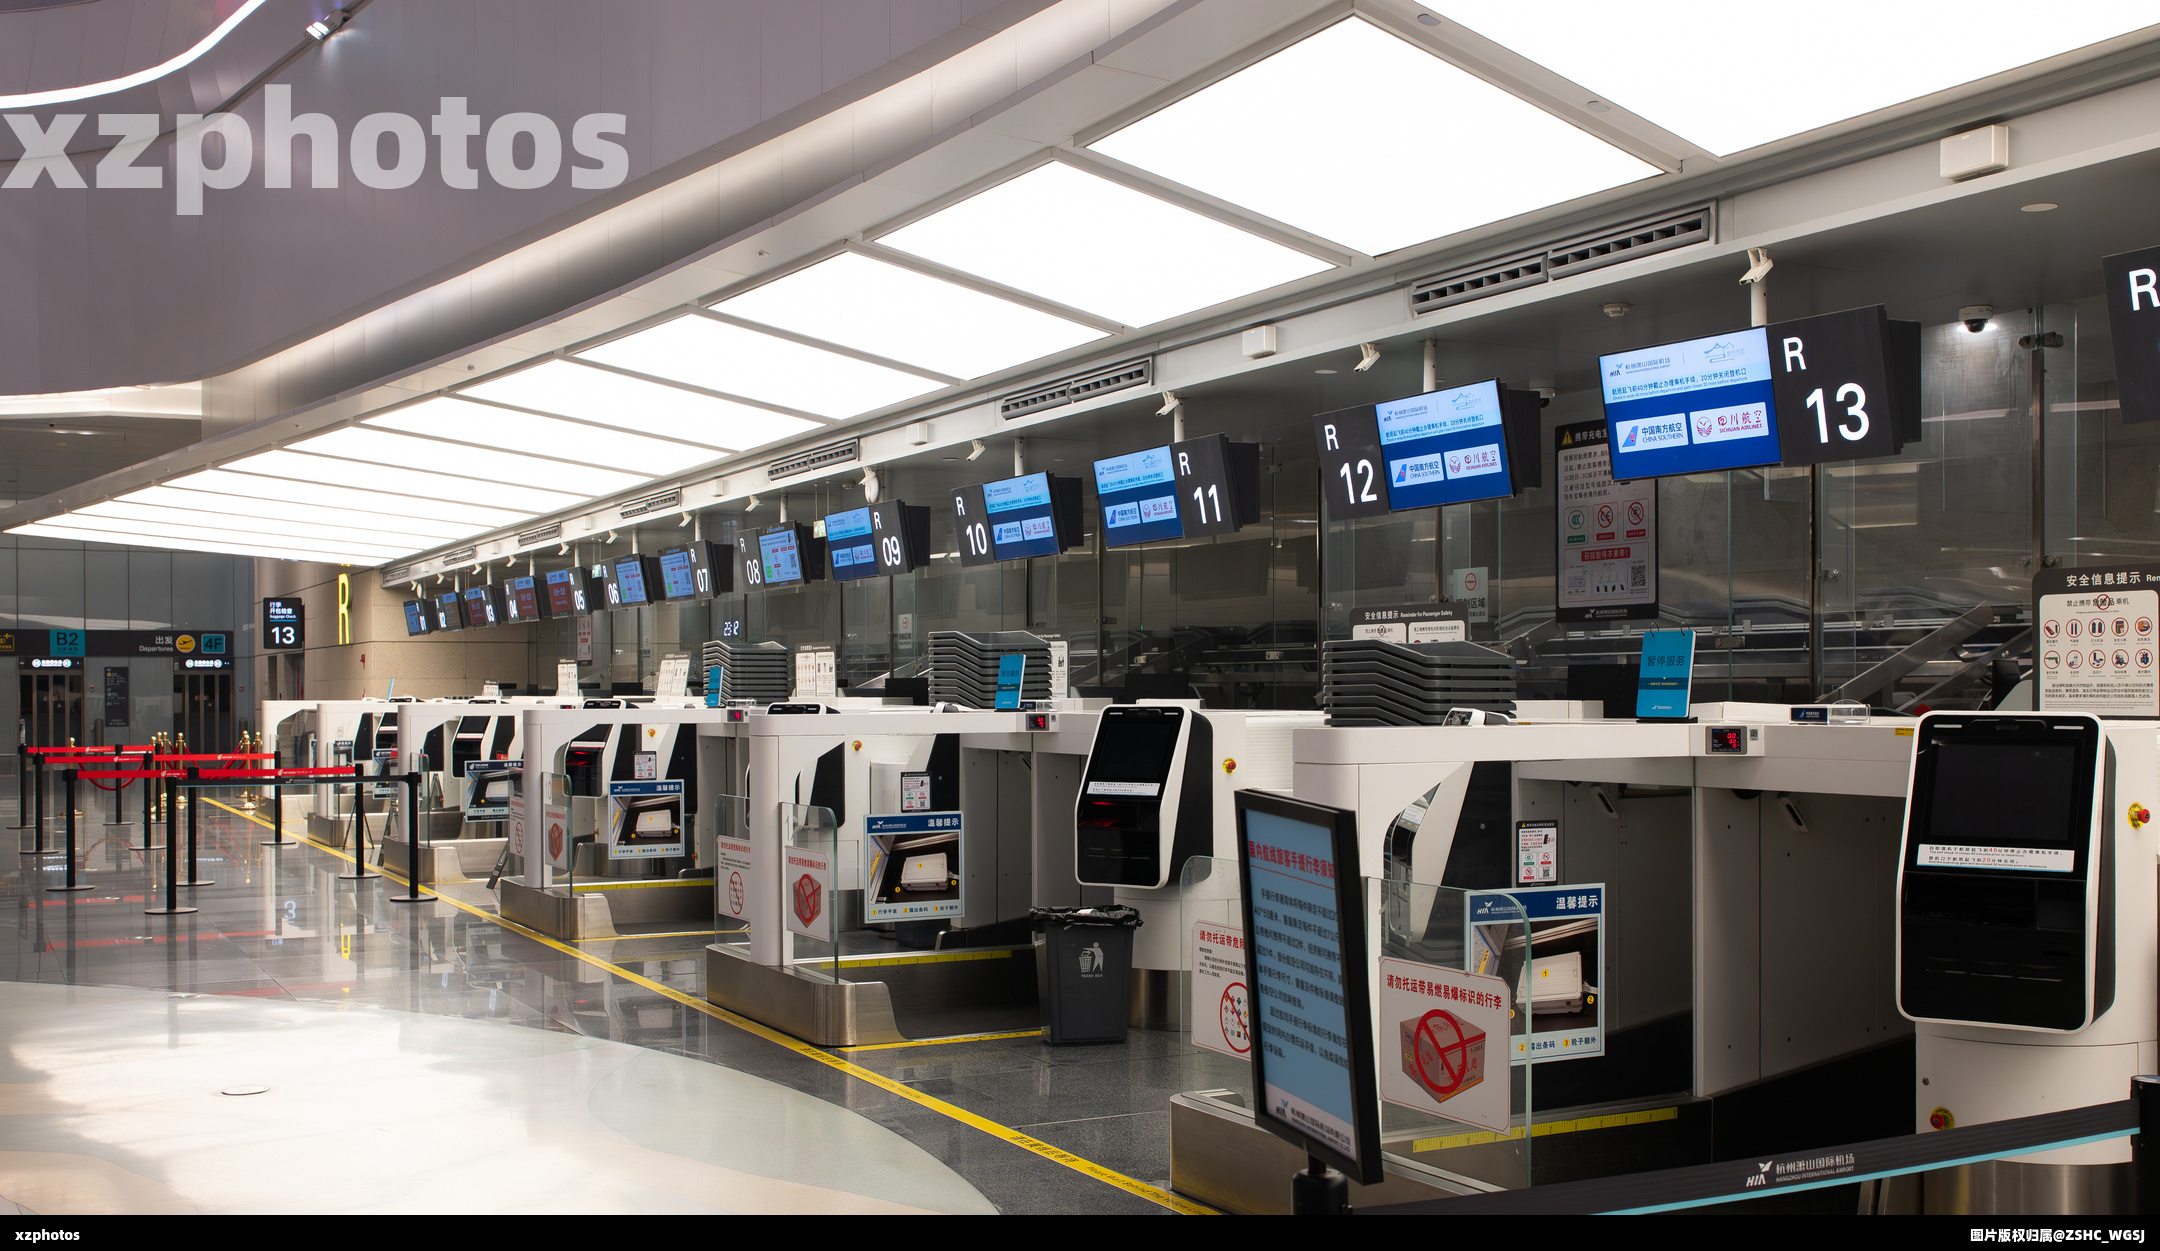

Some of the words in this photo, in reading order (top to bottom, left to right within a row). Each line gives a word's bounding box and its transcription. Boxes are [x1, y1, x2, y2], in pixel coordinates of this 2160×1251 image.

[2129, 268, 2160, 311] R
[1783, 336, 1807, 372] R
[1718, 410, 1762, 426] 四川航空
[1806, 382, 1870, 444] 13
[1642, 422, 1682, 436] 中国南方航空
[1741, 423, 1763, 431] AIRLINES
[1324, 424, 1339, 450] R
[1643, 435, 1657, 443] CHINA
[1658, 433, 1684, 442] SOUTHERN
[1178, 452, 1191, 476] R
[1464, 450, 1497, 464] 四川航空
[1409, 461, 1439, 472] 中国南方航空
[1340, 458, 1377, 504] 12
[956, 496, 965, 516] R
[1193, 484, 1221, 524] 11
[873, 511, 882, 529] R
[739, 538, 746, 552] R
[966, 522, 987, 555] 10
[690, 549, 697, 563] R
[882, 536, 901, 566] 09
[602, 565, 608, 578] R
[697, 568, 708, 592] 07
[746, 559, 761, 584] 08
[2066, 571, 2141, 588] 安全信息提示
[574, 590, 585, 610] 05
[608, 583, 620, 604] 06
[338, 573, 349, 645] R
[509, 600, 518, 618] 04
[2066, 599, 2091, 607] 禁止携带
[486, 604, 494, 622] 03
[1365, 610, 1399, 620] 安全信息提示
[57, 632, 78, 646] B2
[155, 635, 173, 645] 出发
[205, 638, 223, 650] 4F
[271, 626, 295, 644] 13
[1647, 655, 1685, 667] 暂停服务
[927, 817, 960, 828] 温馨提示
[1556, 894, 1598, 909] 温馨提示
[1387, 974, 1502, 1010] 请勿托运带易燃易爆标识的行李
[1776, 1153, 1854, 1175] 杭州萧山国际机场
[1746, 1173, 1766, 1187] HIA
[1776, 1174, 1801, 1183] HANGZHOU
[1802, 1168, 1836, 1179] INTERNATIONAL
[1836, 1165, 1854, 1174] AIRPORT
